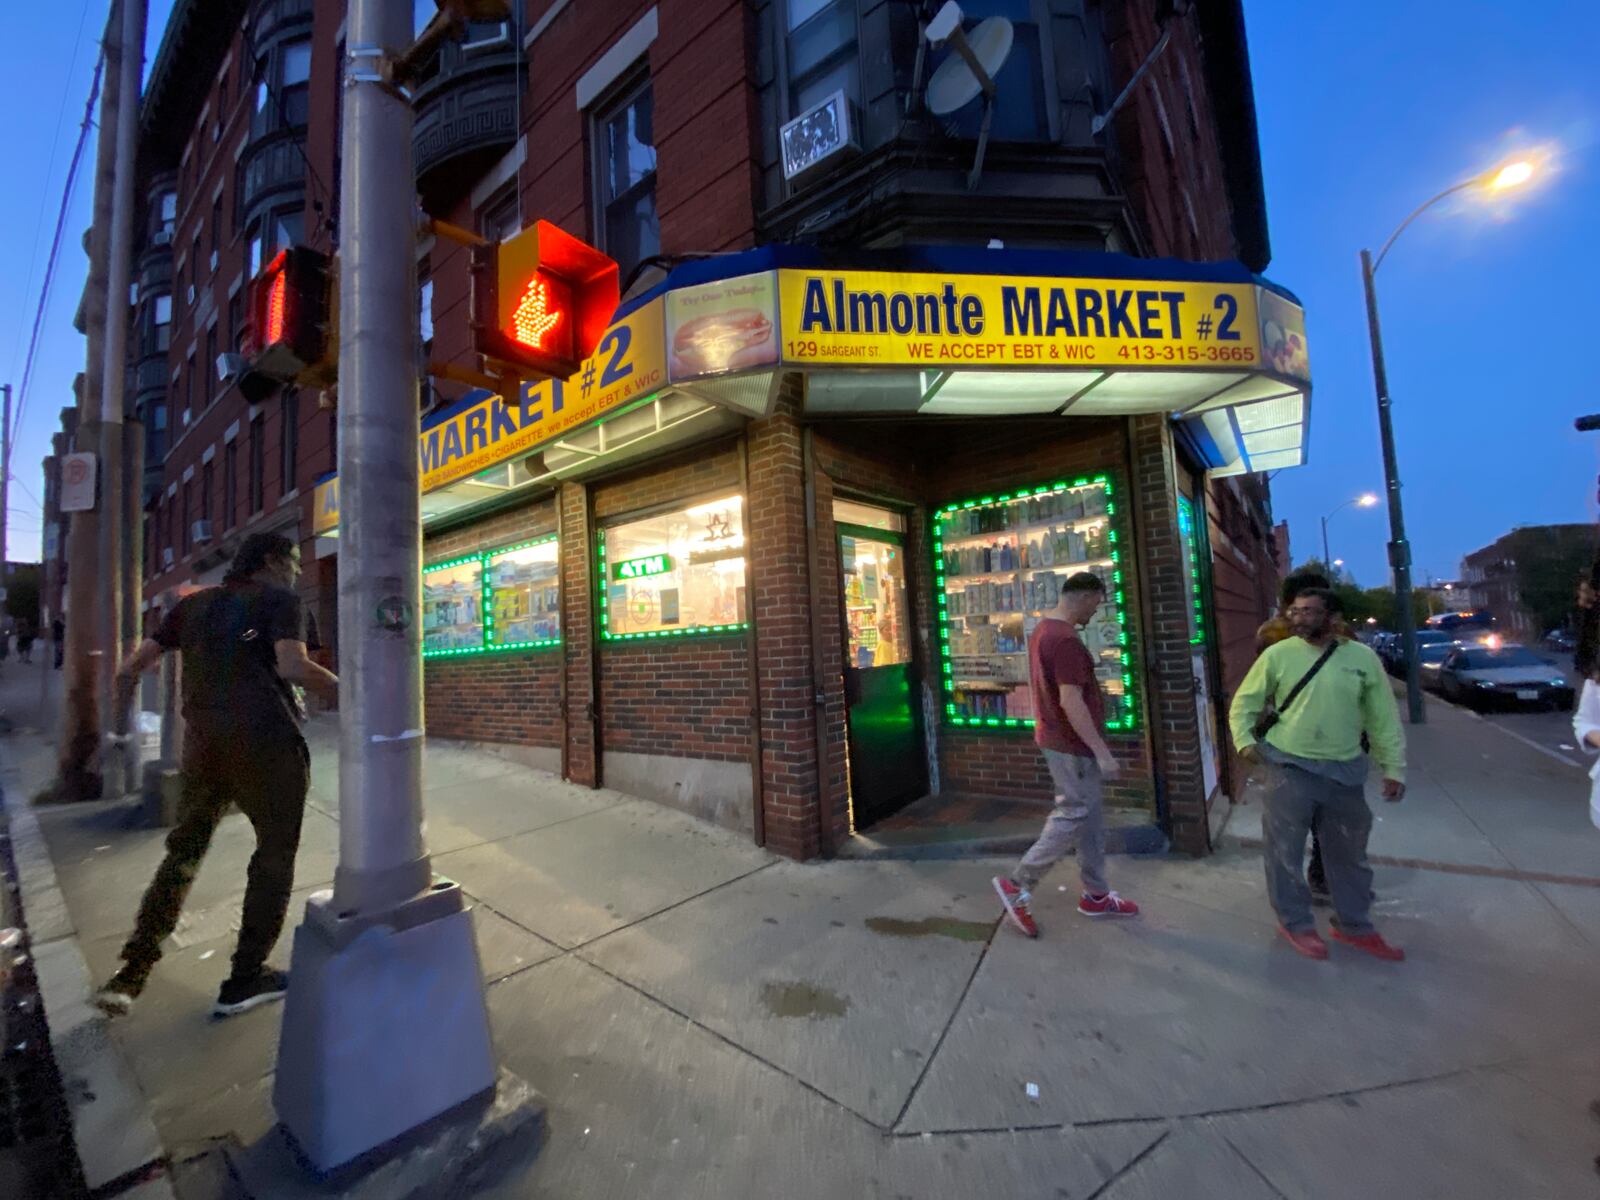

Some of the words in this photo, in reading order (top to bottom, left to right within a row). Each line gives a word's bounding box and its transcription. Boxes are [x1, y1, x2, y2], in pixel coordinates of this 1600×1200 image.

[800, 277, 985, 336] Almonte
[1001, 286, 1186, 339] MARKET
[1197, 293, 1241, 341] #2
[580, 325, 634, 399] #2
[787, 341, 818, 357] 129
[821, 345, 866, 357] SARGEANT
[907, 343, 934, 358] WE
[939, 343, 1006, 359] ACCEPT
[1013, 344, 1044, 359] EBT
[1050, 345, 1060, 359] &
[1064, 345, 1096, 359] WIC
[1118, 345, 1255, 361] 413-315-3665
[548, 421, 563, 433] we
[563, 402, 596, 427] accept
[598, 388, 623, 409] EBT
[634, 368, 661, 390] WIC
[495, 428, 543, 458] CIGARETTE
[620, 555, 665, 577] ATM
